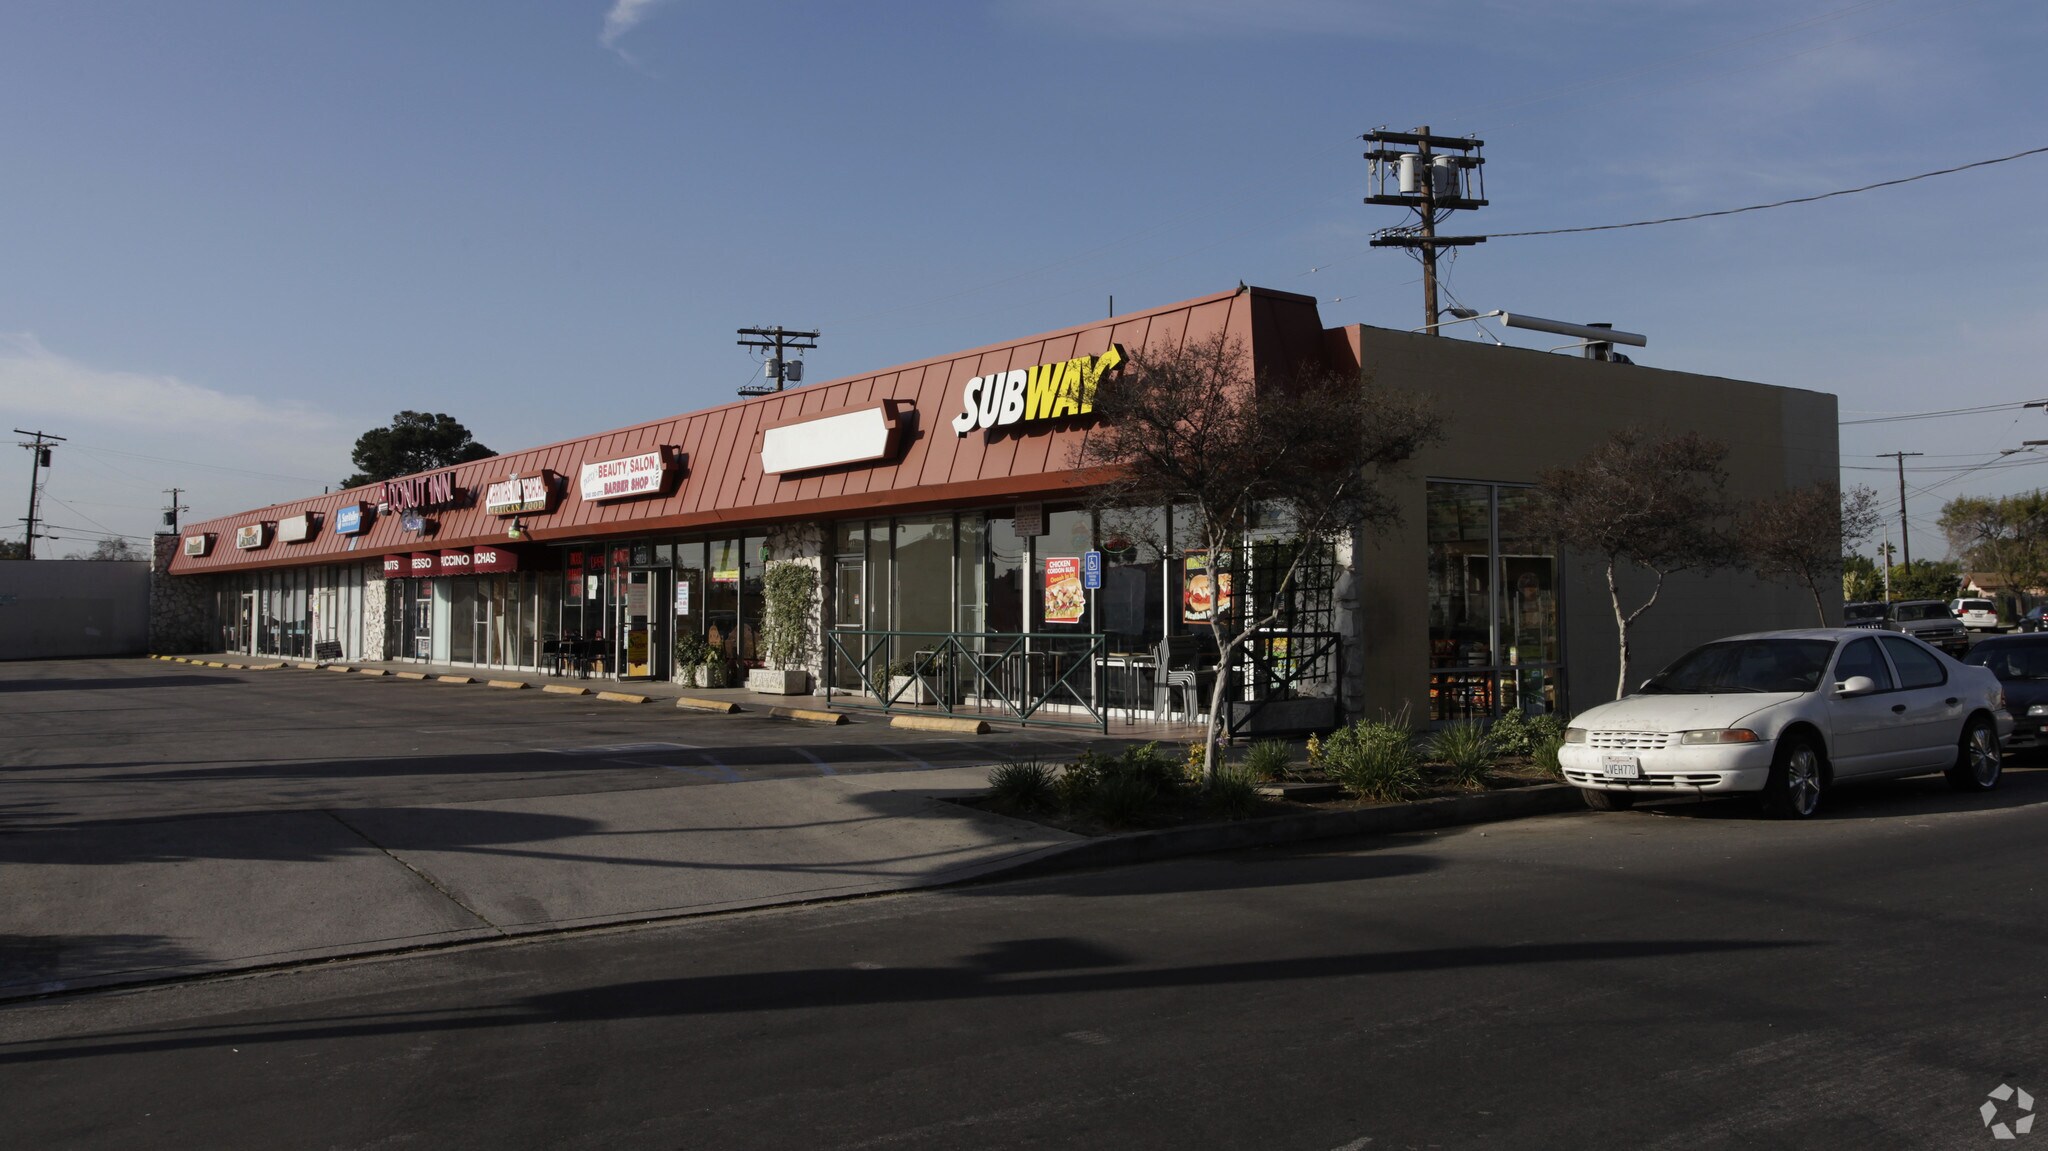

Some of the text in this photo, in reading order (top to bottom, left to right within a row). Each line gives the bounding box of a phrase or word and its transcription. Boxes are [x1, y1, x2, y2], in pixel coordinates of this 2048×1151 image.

[952, 343, 1122, 437] SUBWAY
[598, 461, 627, 478] BEAUTY
[630, 456, 655, 473] SALON
[388, 476, 426, 512] DONUT
[604, 479, 629, 495] BARBER
[631, 476, 649, 491] SHOP
[489, 501, 544, 514] MEXICAN FOOD
[1049, 560, 1071, 568] CHICKEN
[1605, 764, 1636, 776] 4VEH770
